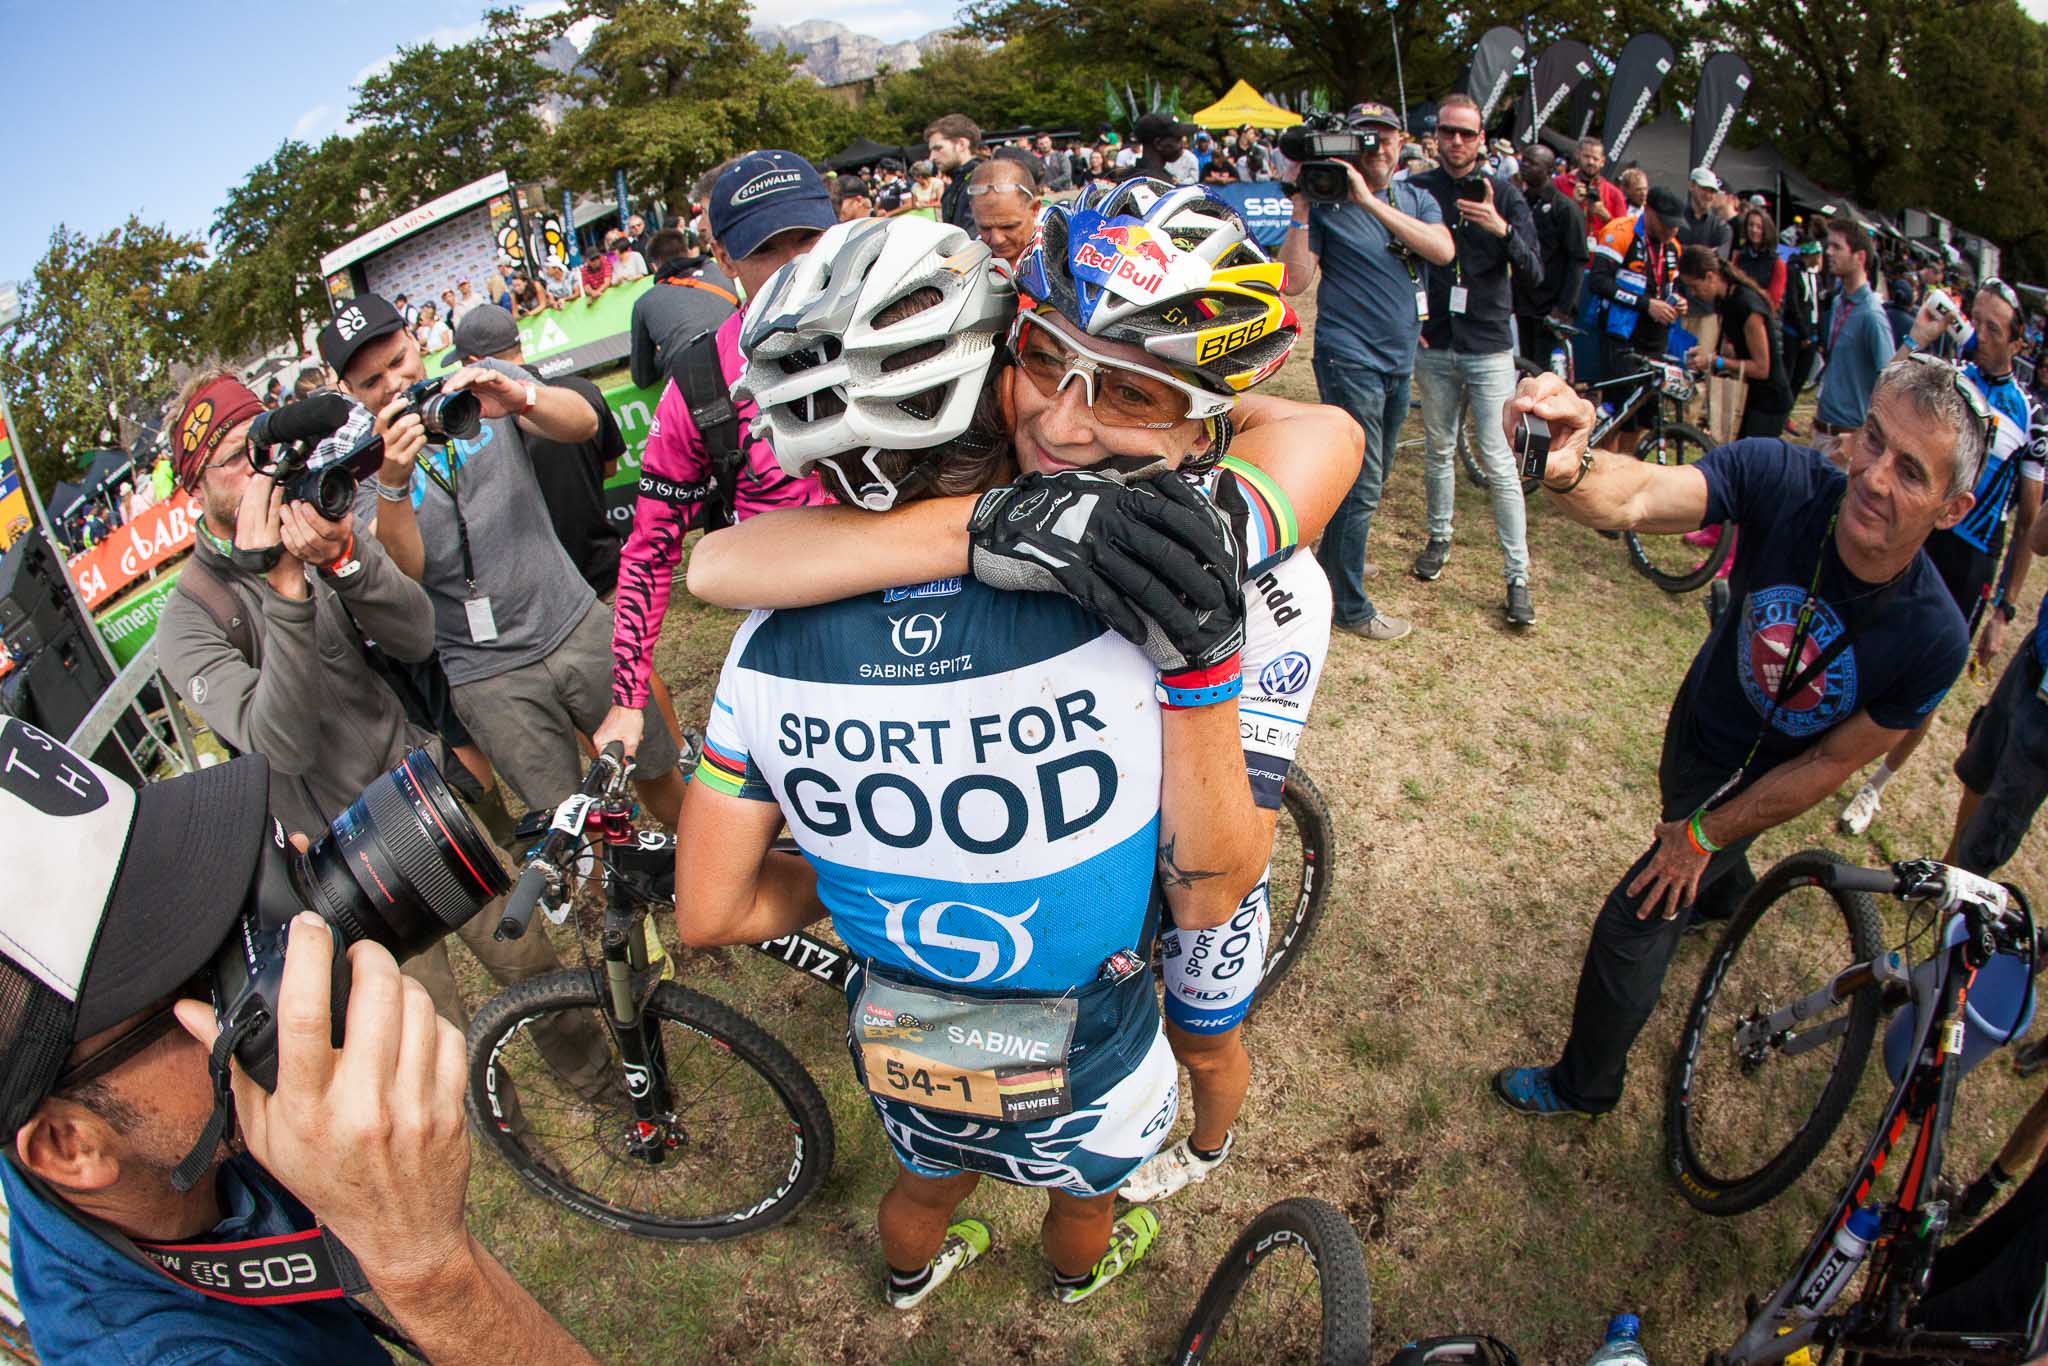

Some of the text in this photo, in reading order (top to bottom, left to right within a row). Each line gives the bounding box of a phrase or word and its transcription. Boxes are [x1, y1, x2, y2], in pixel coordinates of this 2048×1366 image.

[741, 173, 801, 199] SCHWALBE
[1075, 243, 1164, 295] Red Bull
[1199, 316, 1268, 363] BBB
[860, 655, 973, 679] SABINE SPITZ
[778, 690, 1107, 765] SPORT FOR
[784, 749, 1118, 854] GOOD
[1182, 986, 1230, 1001] FILA
[1184, 1013, 1234, 1028] AHC
[947, 1025, 1050, 1063] SABINE
[887, 1058, 973, 1103] 54-1
[1007, 1096, 1060, 1112] NEWBIE
[239, 1253, 317, 1289] EOS
[1808, 1256, 1845, 1302] Tacx
